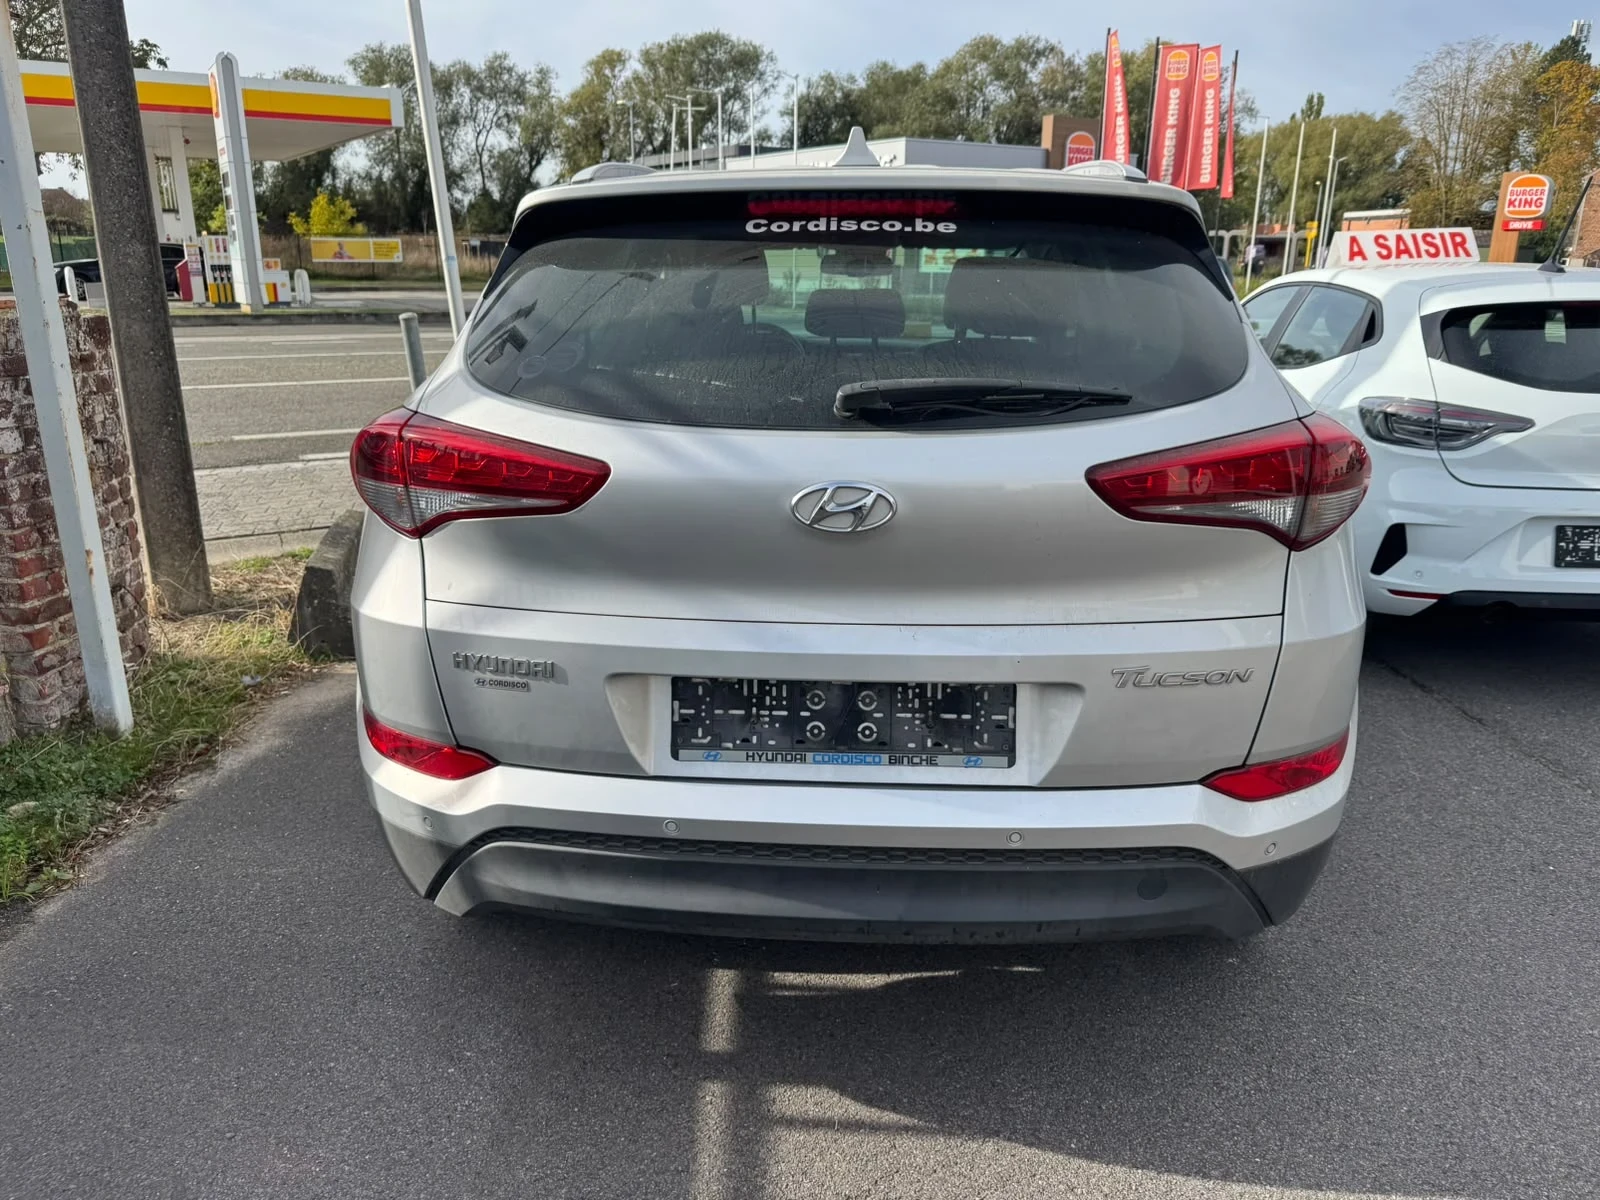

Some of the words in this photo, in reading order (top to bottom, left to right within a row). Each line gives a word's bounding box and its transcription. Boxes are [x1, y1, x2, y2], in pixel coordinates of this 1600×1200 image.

[1167, 88, 1181, 125] KING
[1204, 88, 1215, 125] KING
[1160, 127, 1177, 184] BURGER
[1200, 127, 1214, 183] BURGER
[1507, 197, 1544, 209] KING
[1509, 188, 1546, 197] BURGER
[745, 217, 958, 233] Cordisco.be
[1508, 221, 1534, 230] DRIVE
[1348, 235, 1368, 262] A
[1373, 231, 1473, 261] SAISIR
[452, 652, 555, 679] HYUNDAI
[488, 679, 527, 689] CORDISCO
[745, 751, 807, 763] HYUNDAI
[812, 753, 882, 765] CORDISCO
[888, 755, 939, 766] BINCHE
